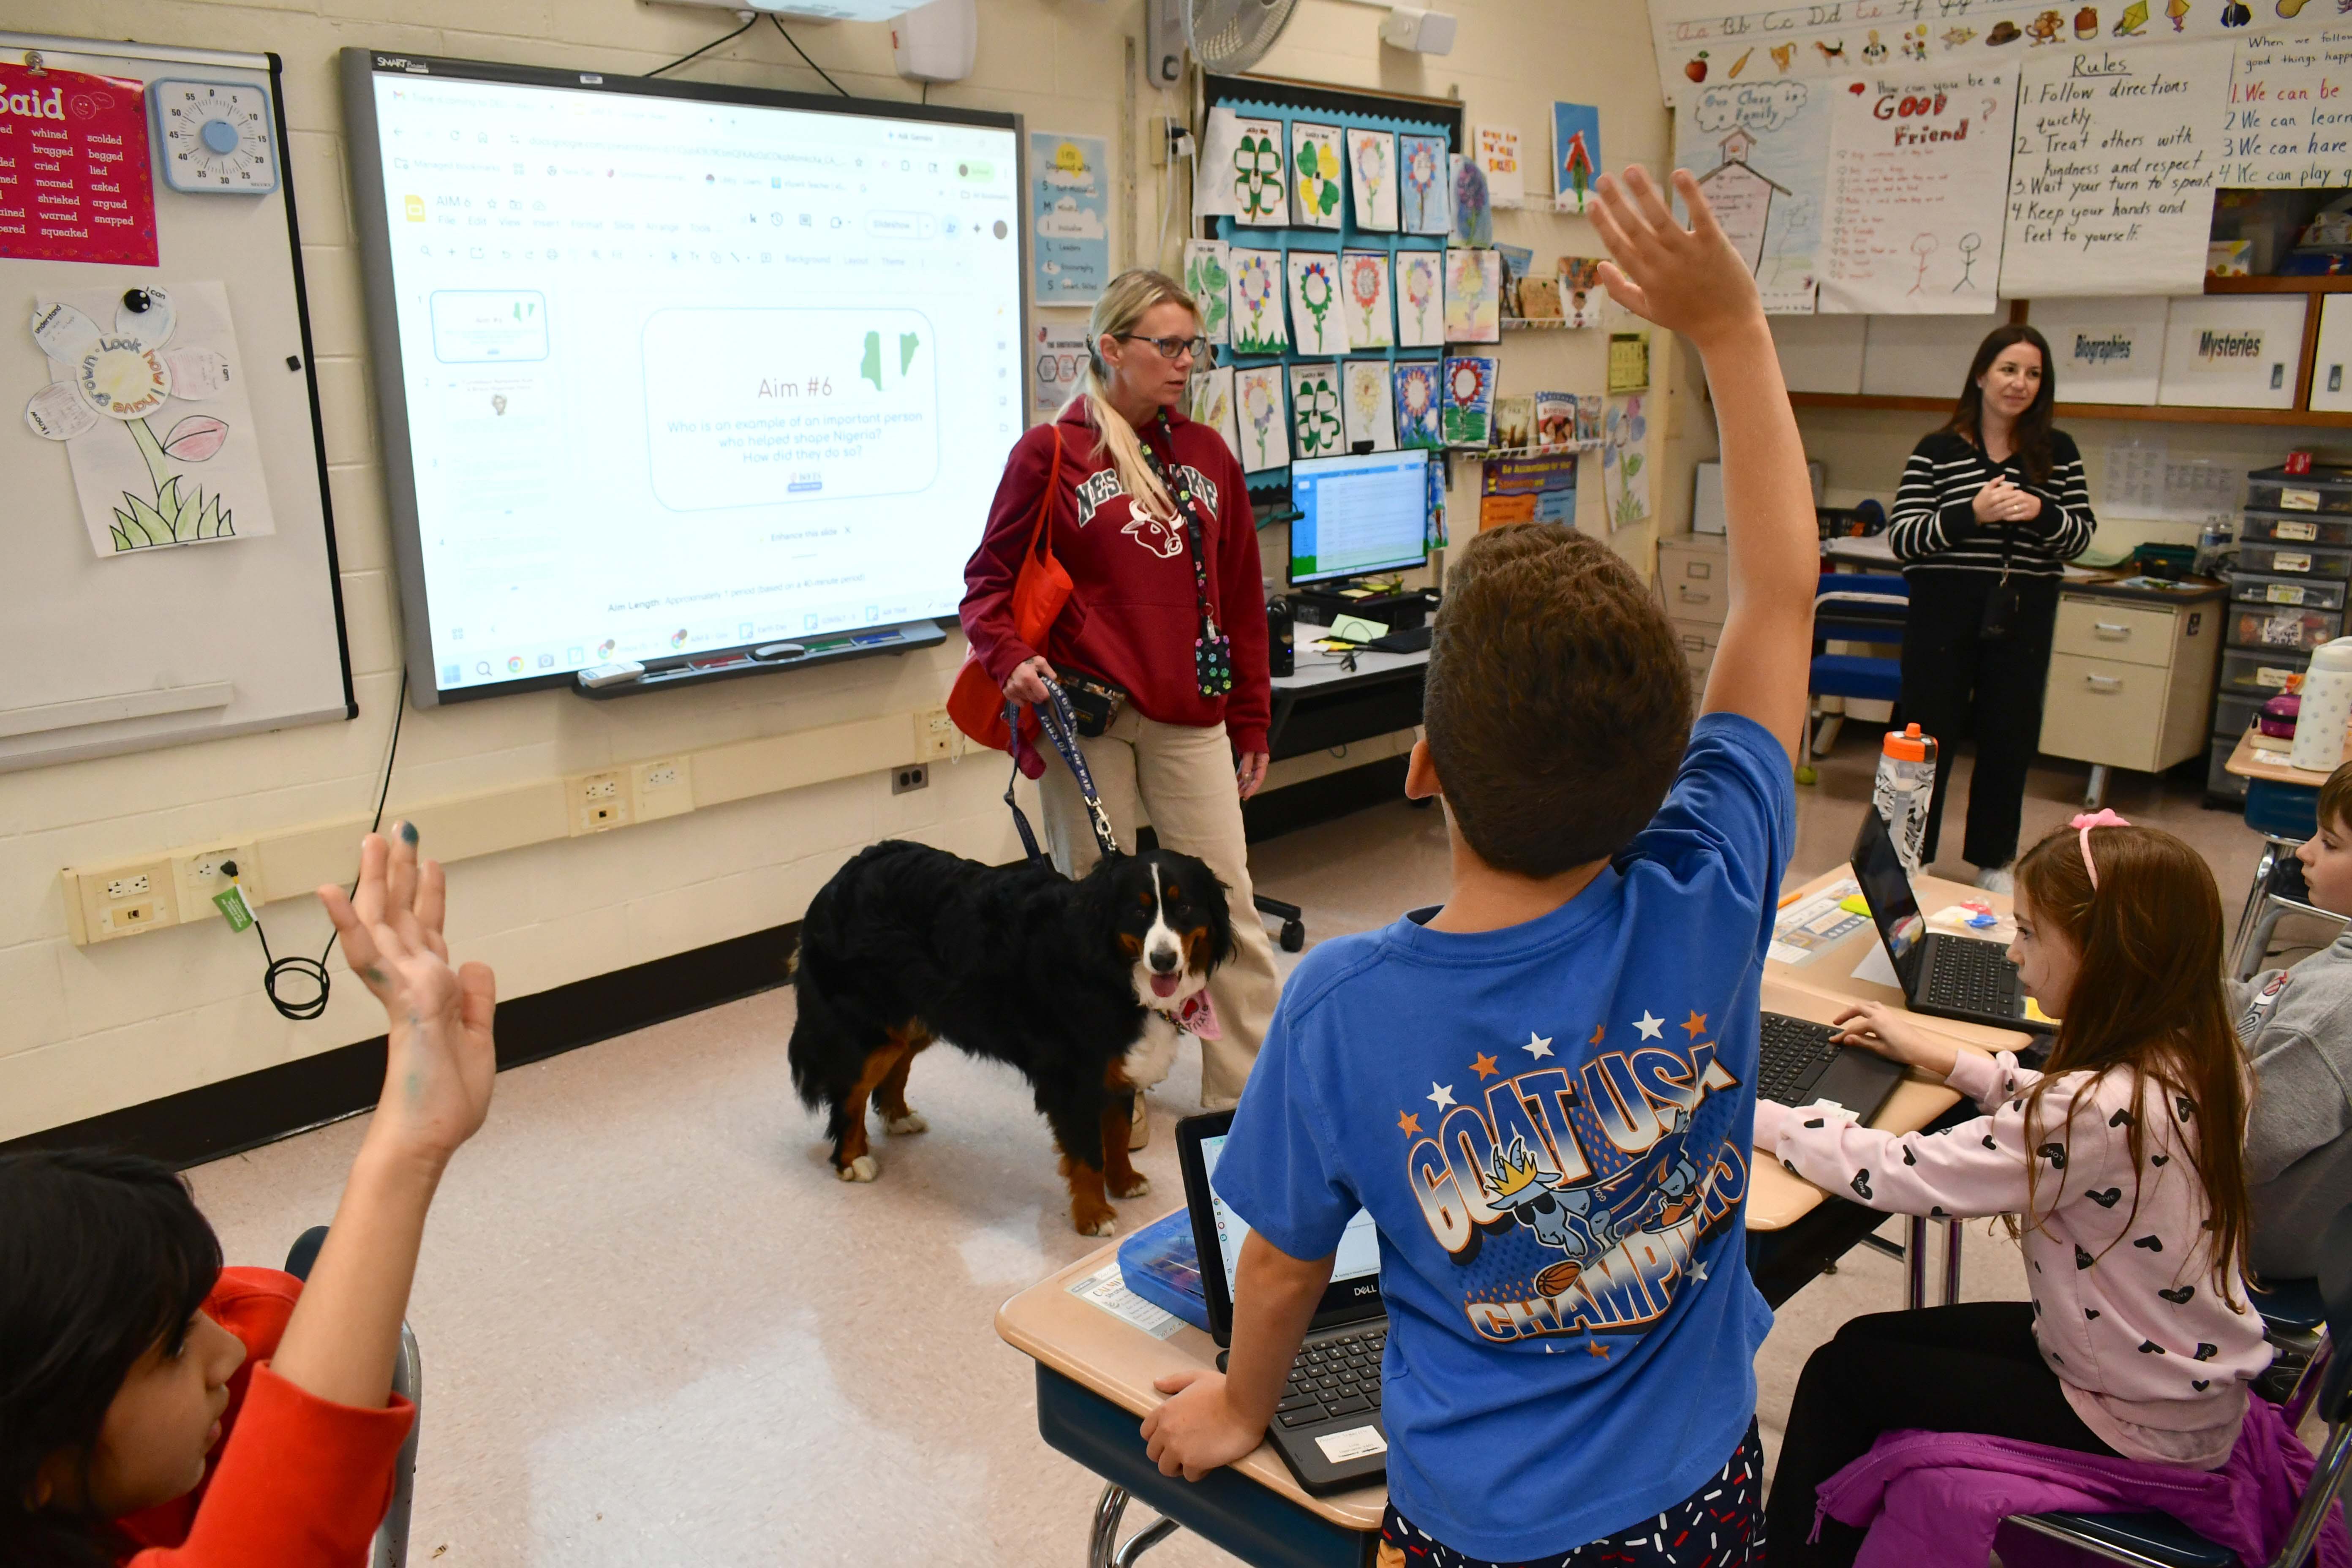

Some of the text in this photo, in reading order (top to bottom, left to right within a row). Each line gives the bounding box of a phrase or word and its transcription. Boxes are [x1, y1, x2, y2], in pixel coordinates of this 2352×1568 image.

[1762, 11, 1794, 31] Cc
[1807, 4, 1842, 27] Dd
[2248, 36, 2284, 48] When
[377, 56, 406, 68] SMART
[2072, 52, 2127, 77] Rules
[2244, 54, 2317, 74] good things
[1877, 81, 1900, 95] How
[1905, 85, 1926, 94] can
[1933, 81, 1959, 96] you
[1968, 73, 1984, 87] be
[2040, 73, 2189, 104] Follow directions
[2245, 81, 2265, 102] We
[2277, 87, 2308, 101] can
[2319, 77, 2340, 100] be
[1873, 93, 1948, 121] GOOD
[2036, 107, 2096, 135] quickly.
[2224, 111, 2235, 131] 2
[2242, 109, 2261, 128] We
[2270, 116, 2297, 127] can
[31, 128, 68, 140] whined
[87, 134, 122, 145] scolded
[1894, 118, 1970, 147] Friend
[2046, 125, 2193, 153] Treat others with
[33, 144, 74, 158] bragged
[2222, 131, 2347, 157] 3 We can have
[88, 149, 123, 162] begged
[35, 162, 60, 172] cried
[90, 165, 108, 175] lied
[2044, 150, 2203, 182] kindness and respect
[2219, 163, 2231, 183] 4
[2238, 162, 2259, 183] We
[2267, 171, 2292, 181] can
[2300, 161, 2331, 187] play
[36, 179, 74, 189] moaned
[91, 182, 120, 193] asked
[1042, 180, 1049, 191] S
[2031, 171, 2213, 202] Wait your turn to speak
[38, 194, 80, 206] shrieked
[93, 199, 128, 210] argued
[436, 195, 460, 207] AIM
[1043, 201, 1052, 210] M
[39, 212, 78, 222] warned
[94, 216, 134, 227] snapped
[2028, 197, 2186, 227] Keep your hands and
[41, 227, 88, 239] squeaked
[438, 215, 711, 233] File Edit View Insert Format Slide Arrange Tools
[2024, 223, 2142, 252] feet to yourself.
[784, 253, 906, 266] Background Layout Theme
[150, 289, 166, 300] can
[1047, 280, 1054, 291] S
[35, 305, 62, 334] understand
[2074, 333, 2132, 365] Biographies
[2197, 331, 2261, 363] Mysteries
[99, 338, 166, 414] Look how I have
[223, 368, 230, 381] am
[758, 376, 833, 398] Aim #6
[30, 411, 46, 432] know
[667, 411, 923, 434] Who is an example of an important person
[718, 428, 882, 448] who helped shape Nigeria?
[743, 446, 862, 464] How did they do so?
[1075, 463, 1218, 529] NESKE
[770, 527, 838, 542] Enhance this slide
[607, 602, 626, 612] Aim
[665, 591, 721, 607] Approximately
[730, 586, 756, 598] period
[1407, 1040, 1739, 1254] GOAT USA
[1857, 1176, 1866, 1193] LOVE
[1353, 1285, 1377, 1296] DELL
